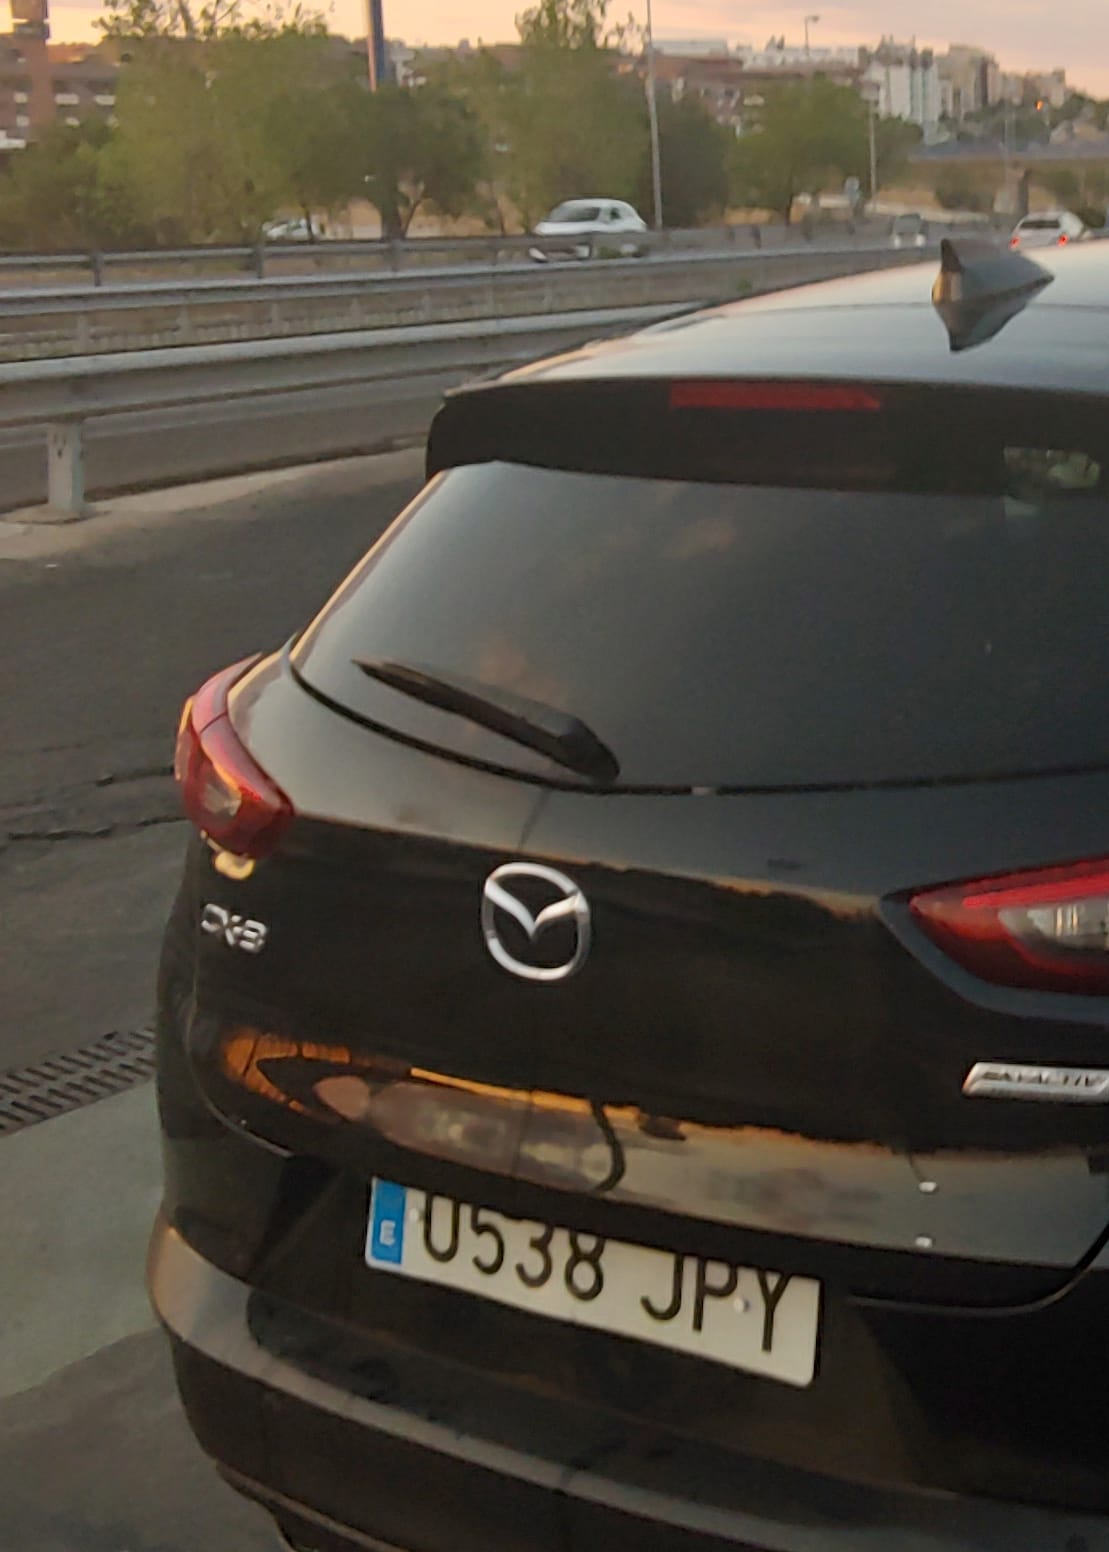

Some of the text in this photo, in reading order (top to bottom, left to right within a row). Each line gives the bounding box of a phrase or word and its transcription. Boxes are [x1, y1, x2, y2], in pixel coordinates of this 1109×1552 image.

[379, 1192, 793, 1352] E 0538 JPY
